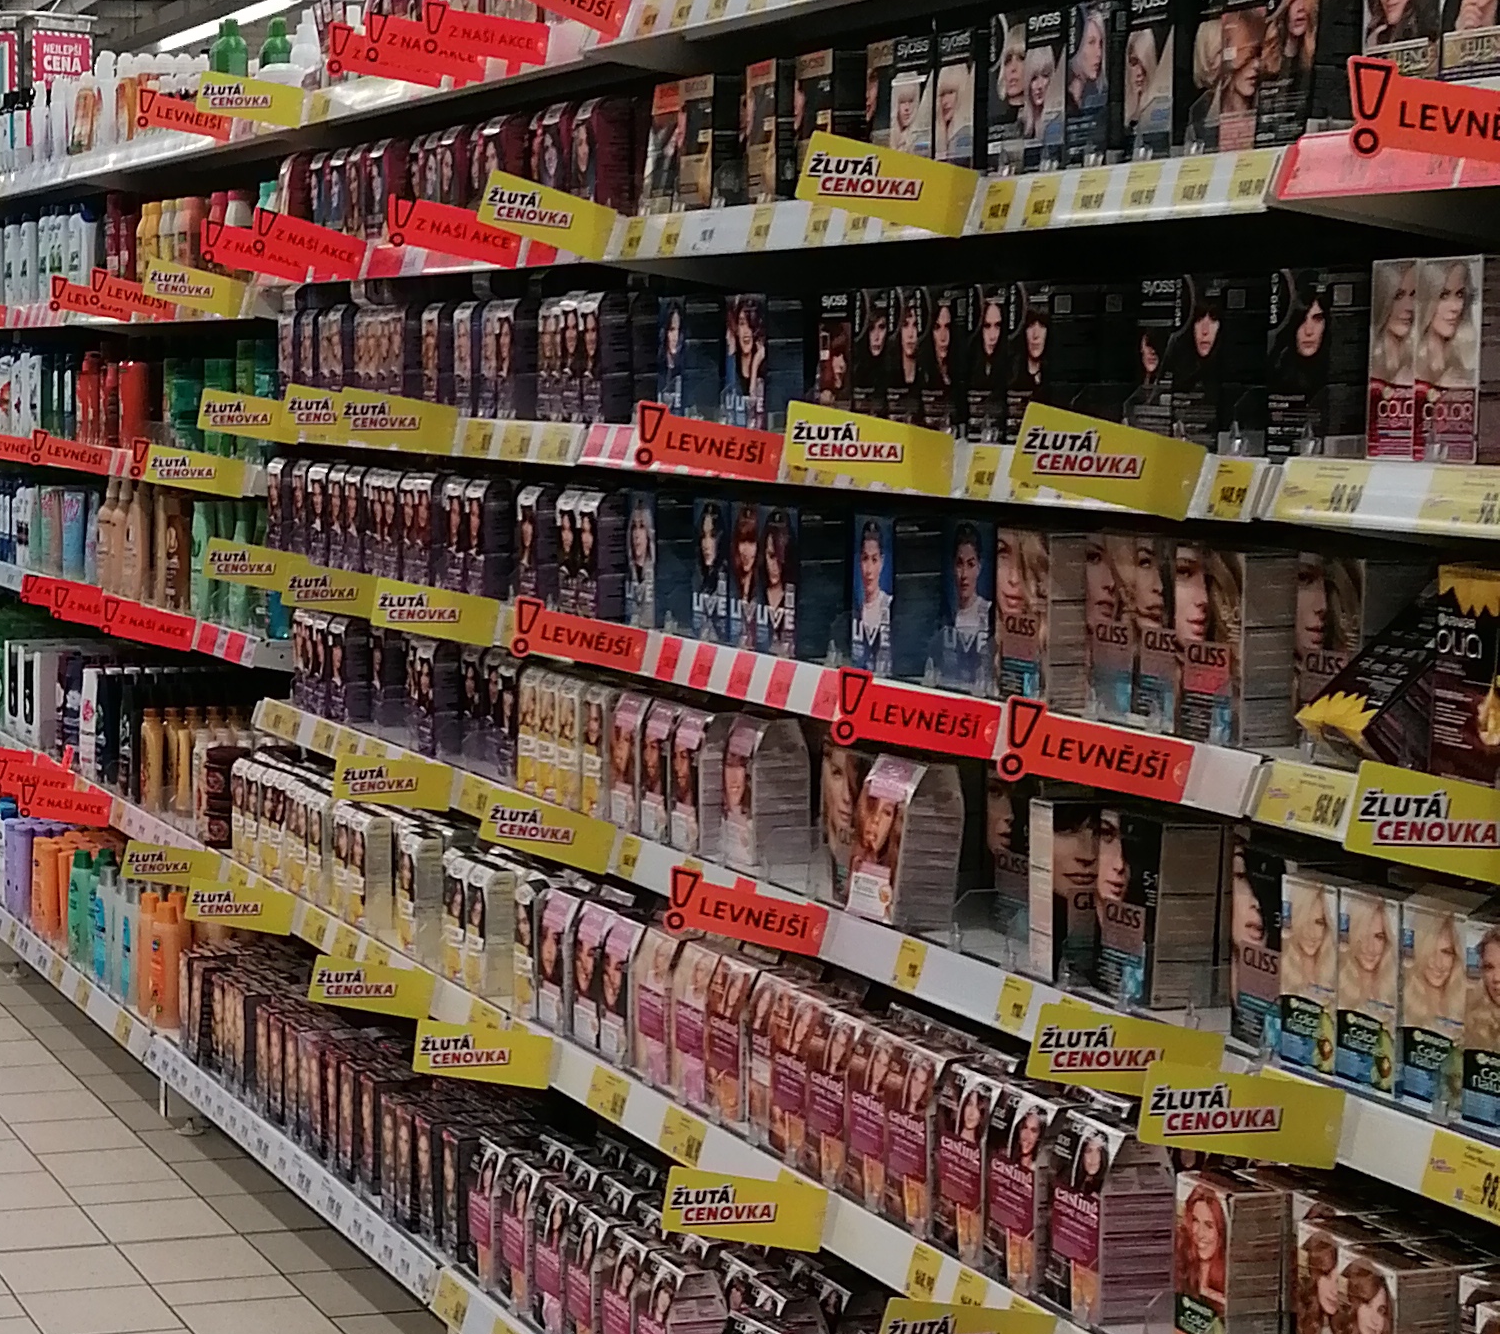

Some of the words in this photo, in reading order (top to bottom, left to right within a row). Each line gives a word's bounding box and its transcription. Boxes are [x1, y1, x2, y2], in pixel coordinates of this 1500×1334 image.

[449, 25, 460, 39] Z
[463, 26, 495, 44] NAŠÍ
[499, 32, 535, 51] AKCE
[43, 43, 82, 56] NEJLEPŠÍ
[44, 56, 82, 72] CENA
[202, 84, 242, 96] ŽLUTÁ
[211, 95, 270, 107] CENOVKA
[156, 107, 222, 129] LEVNĚJŠÍ
[809, 156, 874, 175] ŽLUTÁ
[820, 177, 917, 198] CENOVKA
[488, 186, 539, 207] ŽLUTÁ
[497, 206, 571, 226] CENOVKA
[276, 228, 287, 241] Z
[415, 218, 426, 231] Z
[429, 220, 467, 240] NAŠÍ
[470, 231, 512, 250] AKCE
[151, 270, 187, 284] ŽLUTÁ
[108, 285, 169, 309] LEVNĚJŠÍ
[157, 282, 213, 296] CENOVKA
[204, 401, 243, 413] ŽLUTÁ
[288, 398, 331, 412] ŽLUTÁ
[344, 403, 387, 417] ŽLUTÁ
[212, 412, 269, 425] CENOVKA
[297, 412, 336, 424] CENOV
[352, 416, 418, 428] CENOVKA
[793, 424, 854, 442] ŽLUTÁ
[1024, 429, 1095, 453] ŽLUTÁ
[666, 432, 764, 464] LEVNĚJŠÍ
[807, 443, 900, 460] CENOVKA
[151, 457, 188, 468] ŽLUTÁ
[1036, 454, 1139, 476] CENOVKA
[159, 467, 214, 478] CENOVKA
[209, 552, 246, 563] ŽLUTÁ
[217, 562, 273, 574] CENOVKA
[289, 575, 329, 589] ŽLUTÁ
[296, 587, 356, 600] CENOVKA
[379, 593, 425, 608] ŽLUTÁ
[388, 608, 458, 621] CENOVKA
[541, 622, 632, 657] LEVNĚJŠÍ
[870, 703, 982, 740] LEVNĚJŠÍ
[1041, 733, 1170, 780] LEVNĚJŠÍ
[342, 767, 388, 781] ŽLUTÁ
[350, 778, 415, 792] CENOVKA
[36, 798, 44, 807] Z
[47, 798, 72, 812] NAŠÍ
[74, 803, 104, 816] AKCE
[1362, 790, 1446, 817] ŽLUTÁ
[491, 806, 542, 824] ŽLUTÁ
[499, 823, 573, 843] CENOVKA
[1377, 821, 1497, 843] CENOVKA
[128, 852, 165, 863] ŽLUTÁ
[133, 862, 189, 873] CENOVKA
[192, 892, 234, 904] ŽLUTÁ
[200, 902, 260, 915] CENOVKA
[700, 900, 808, 939] LEVNĚJŠÍ
[317, 971, 364, 987] ŽLUTÁ
[326, 983, 395, 996] CENOVKA
[421, 1035, 471, 1052] ŽLUTÁ
[1040, 1026, 1109, 1048] ŽLUTÁ
[432, 1049, 508, 1065] CENOVKA
[1053, 1049, 1157, 1069] CENOVKA
[1151, 1087, 1227, 1110] ŽLUTÁ
[1167, 1108, 1277, 1130] CENOVKA
[672, 1185, 734, 1206] ŽLUTÁ
[684, 1204, 773, 1222] CENOVKA
